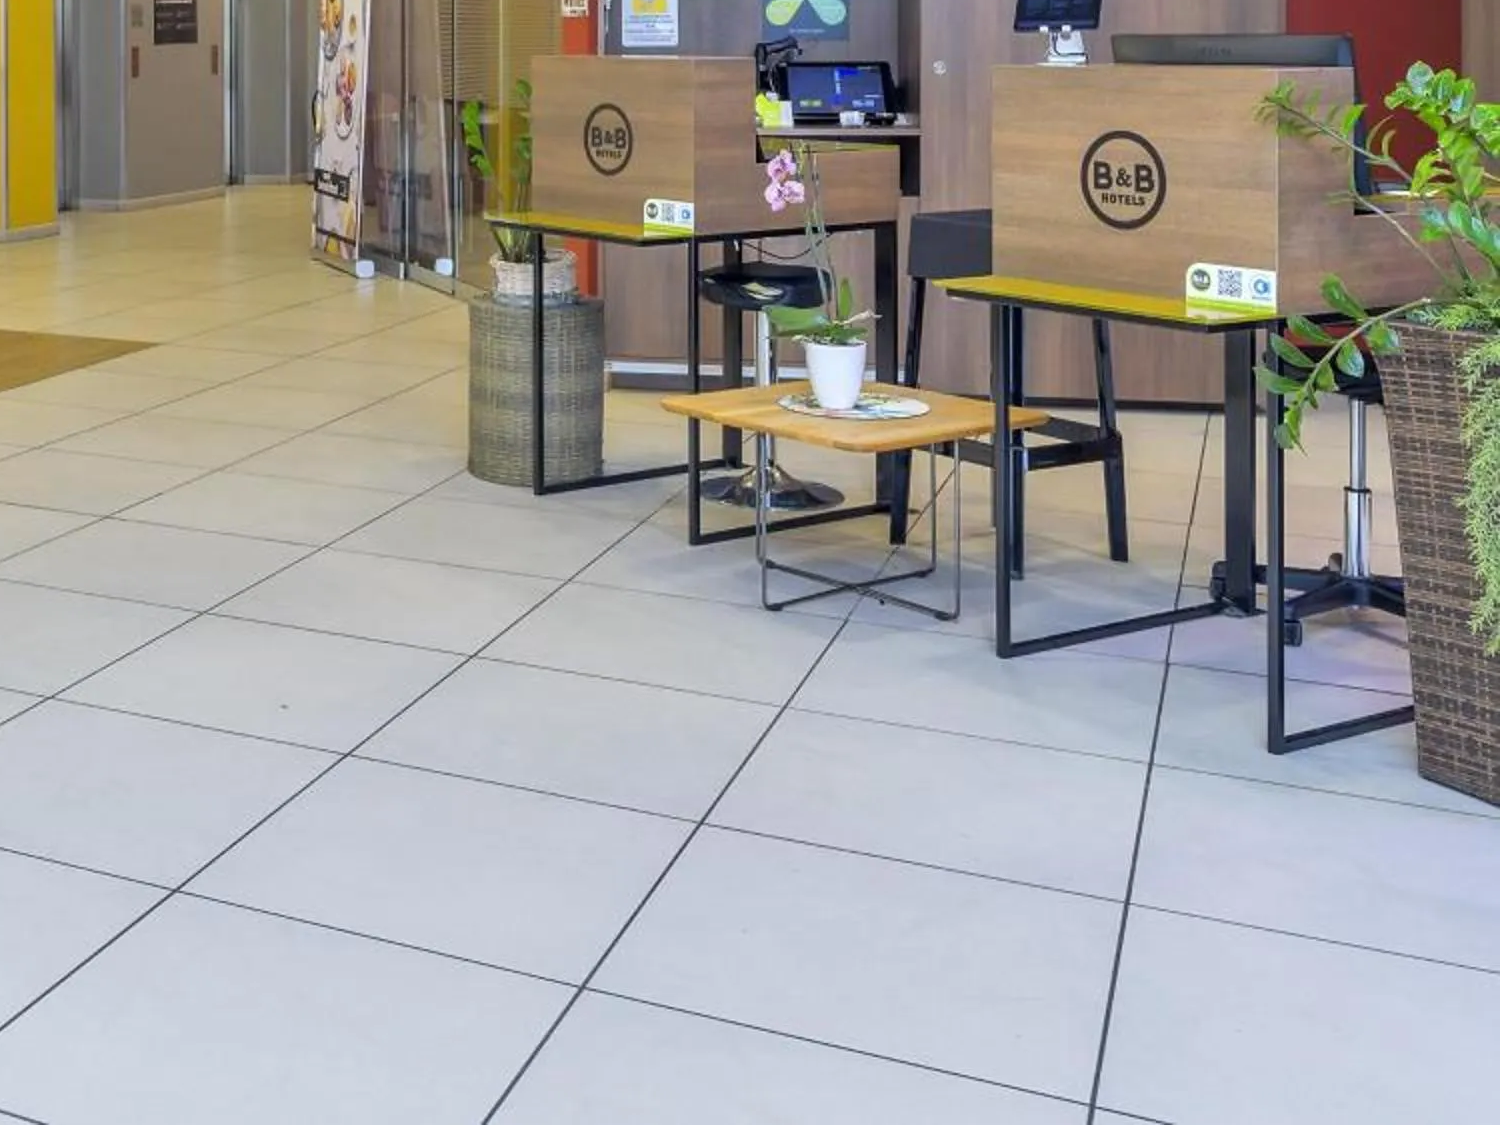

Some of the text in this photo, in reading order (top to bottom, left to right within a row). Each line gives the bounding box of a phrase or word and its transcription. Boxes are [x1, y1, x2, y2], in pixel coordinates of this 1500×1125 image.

[592, 127, 626, 149] B&B
[1093, 161, 1154, 193] B&B
[1101, 193, 1146, 206] HOTELS
